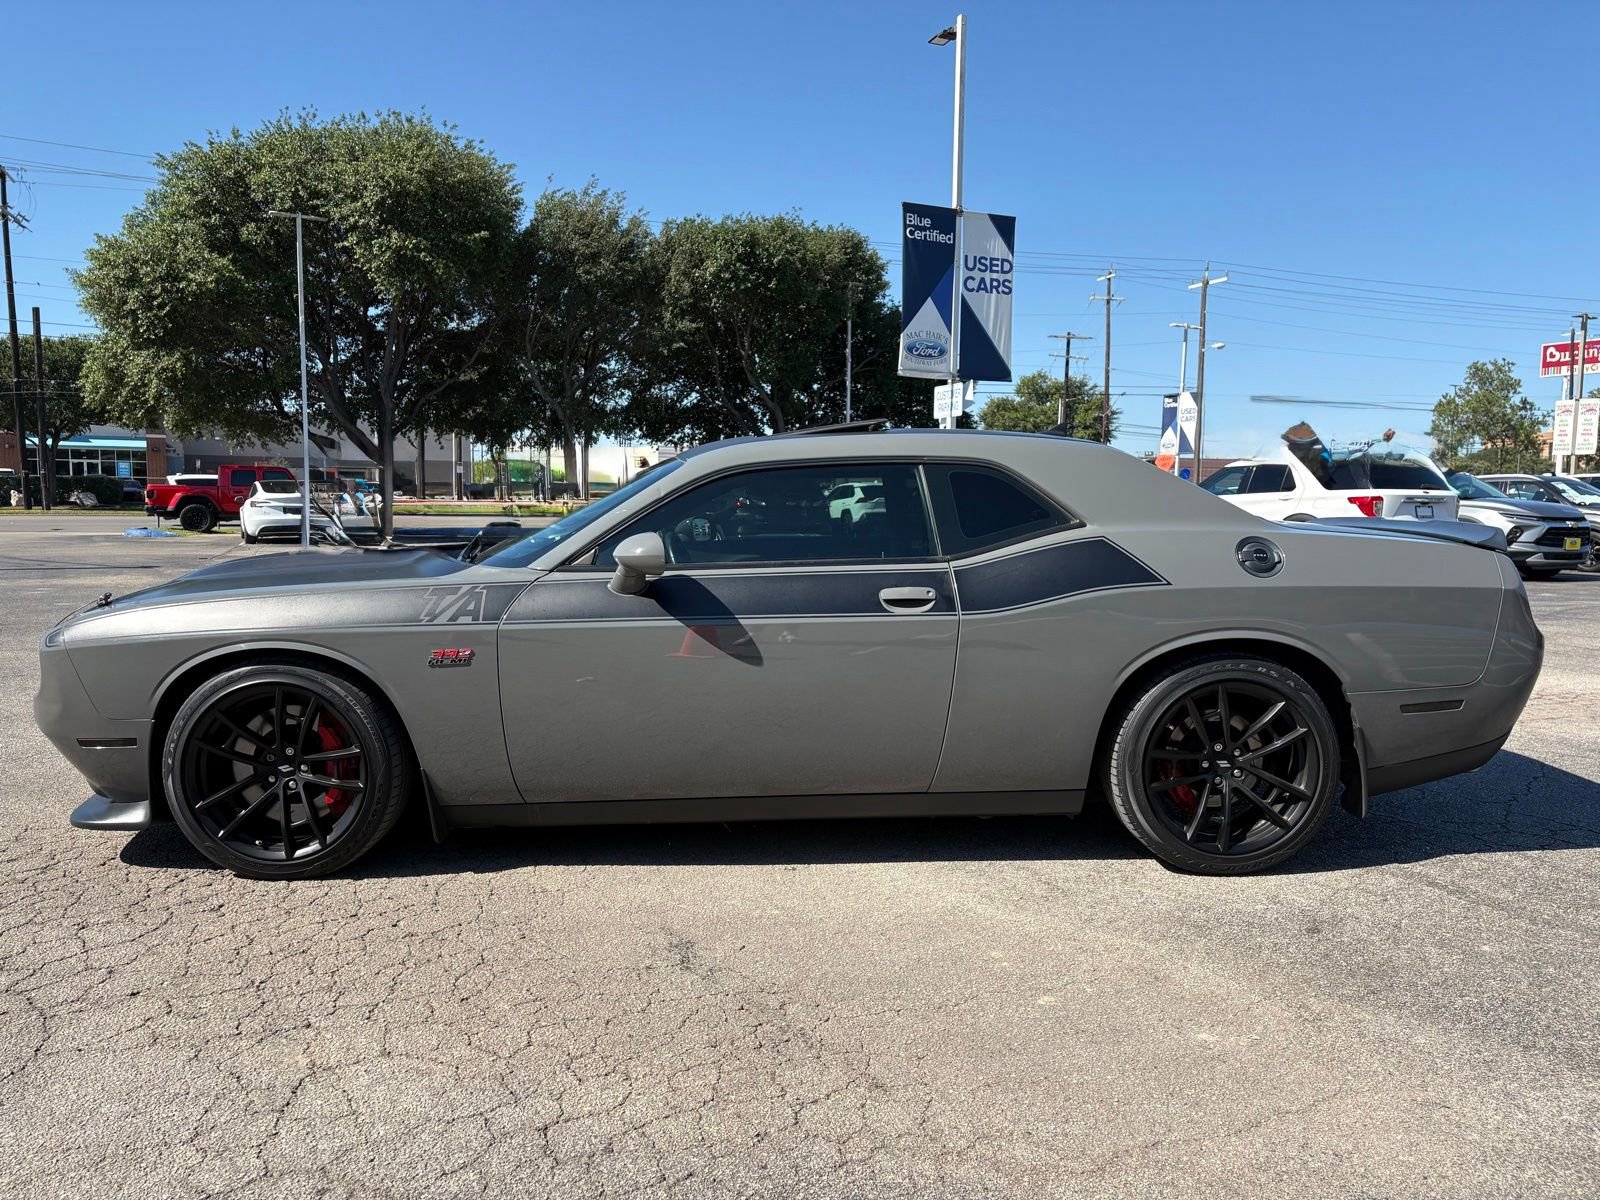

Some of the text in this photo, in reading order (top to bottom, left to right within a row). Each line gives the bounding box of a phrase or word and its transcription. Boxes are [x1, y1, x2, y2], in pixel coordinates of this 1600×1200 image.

[906, 213, 931, 228] Blue
[906, 227, 954, 245] Certified
[964, 254, 1014, 274] USED
[963, 276, 1013, 296] CARS
[906, 330, 948, 345] MAC HAIK'S
[912, 341, 940, 357] Ford
[1546, 346, 1600, 363] Burin
[936, 388, 961, 401] CUSTER
[938, 401, 959, 413] PARKNG
